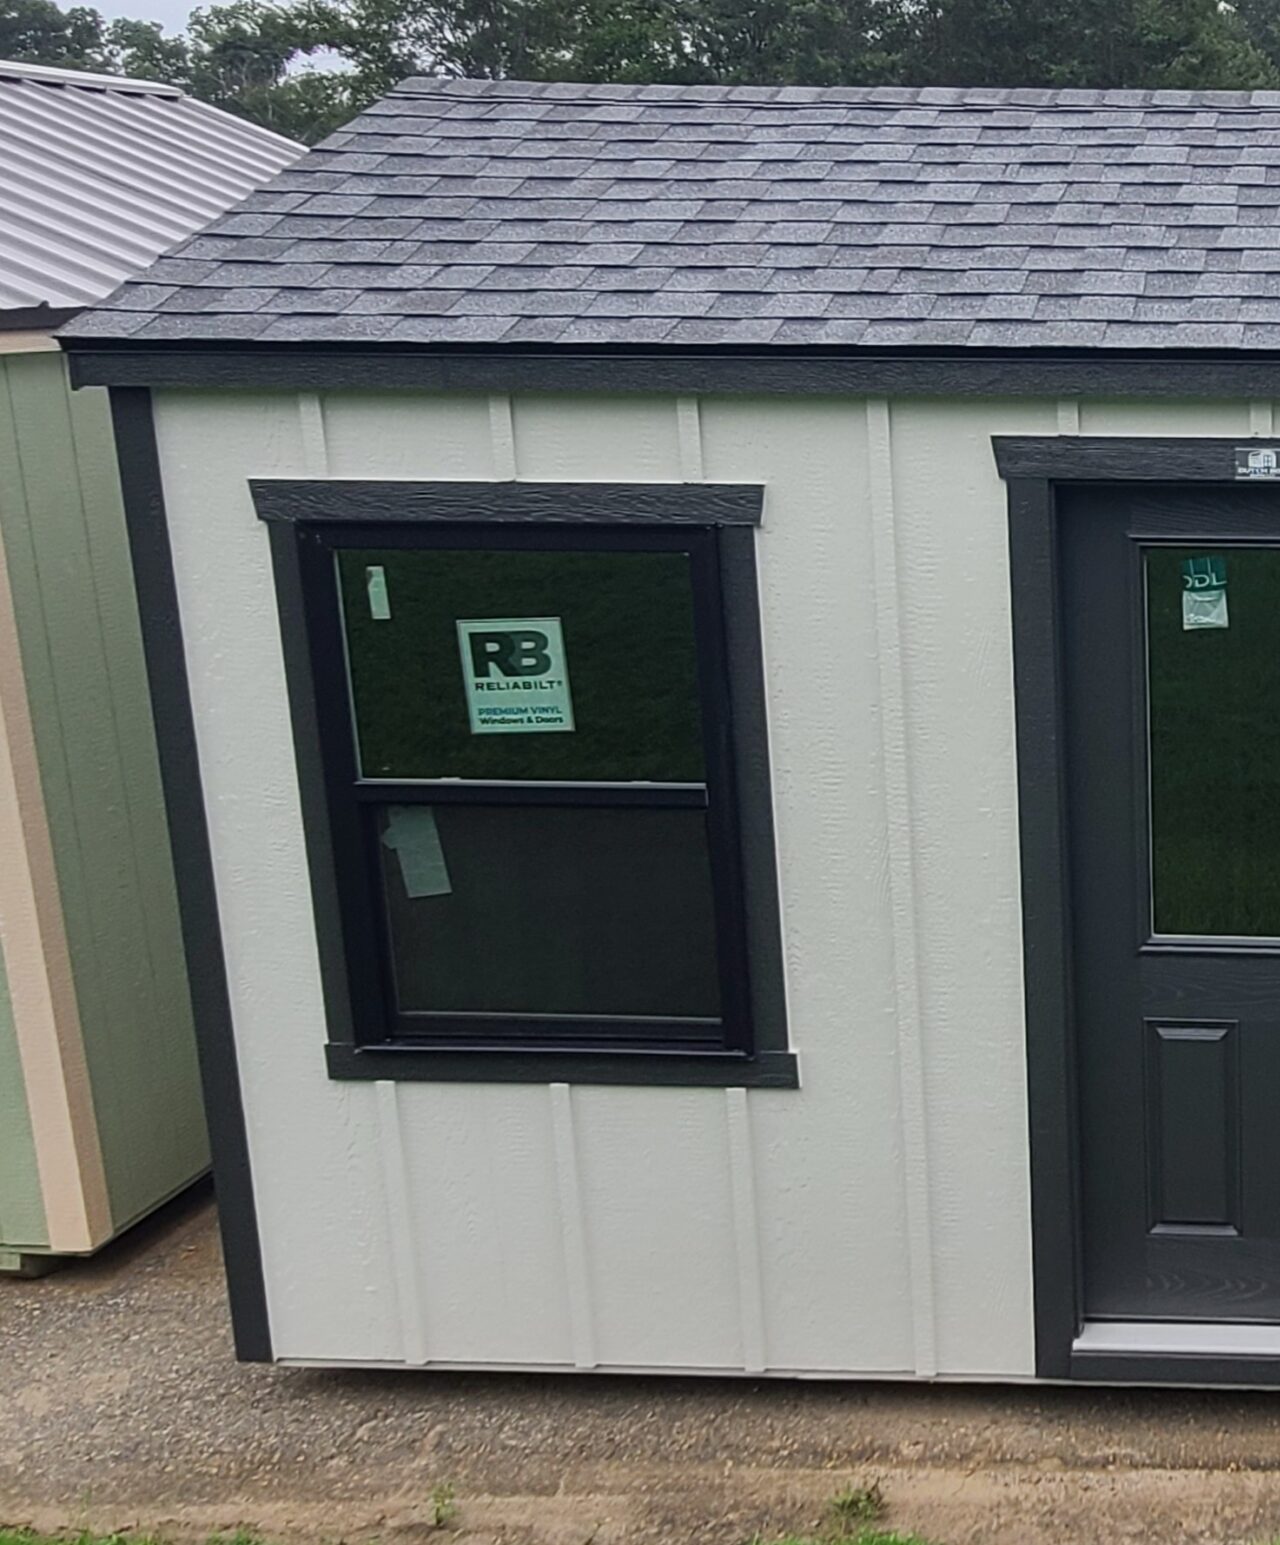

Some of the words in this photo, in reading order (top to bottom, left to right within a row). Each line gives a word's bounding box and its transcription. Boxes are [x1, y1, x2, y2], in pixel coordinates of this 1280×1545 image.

[468, 630, 552, 678] RB
[478, 706, 528, 716] PREMIUM
[531, 705, 563, 715] VINYL
[479, 716, 524, 725] Windows
[526, 716, 534, 724] &
[535, 715, 563, 724] Doors
